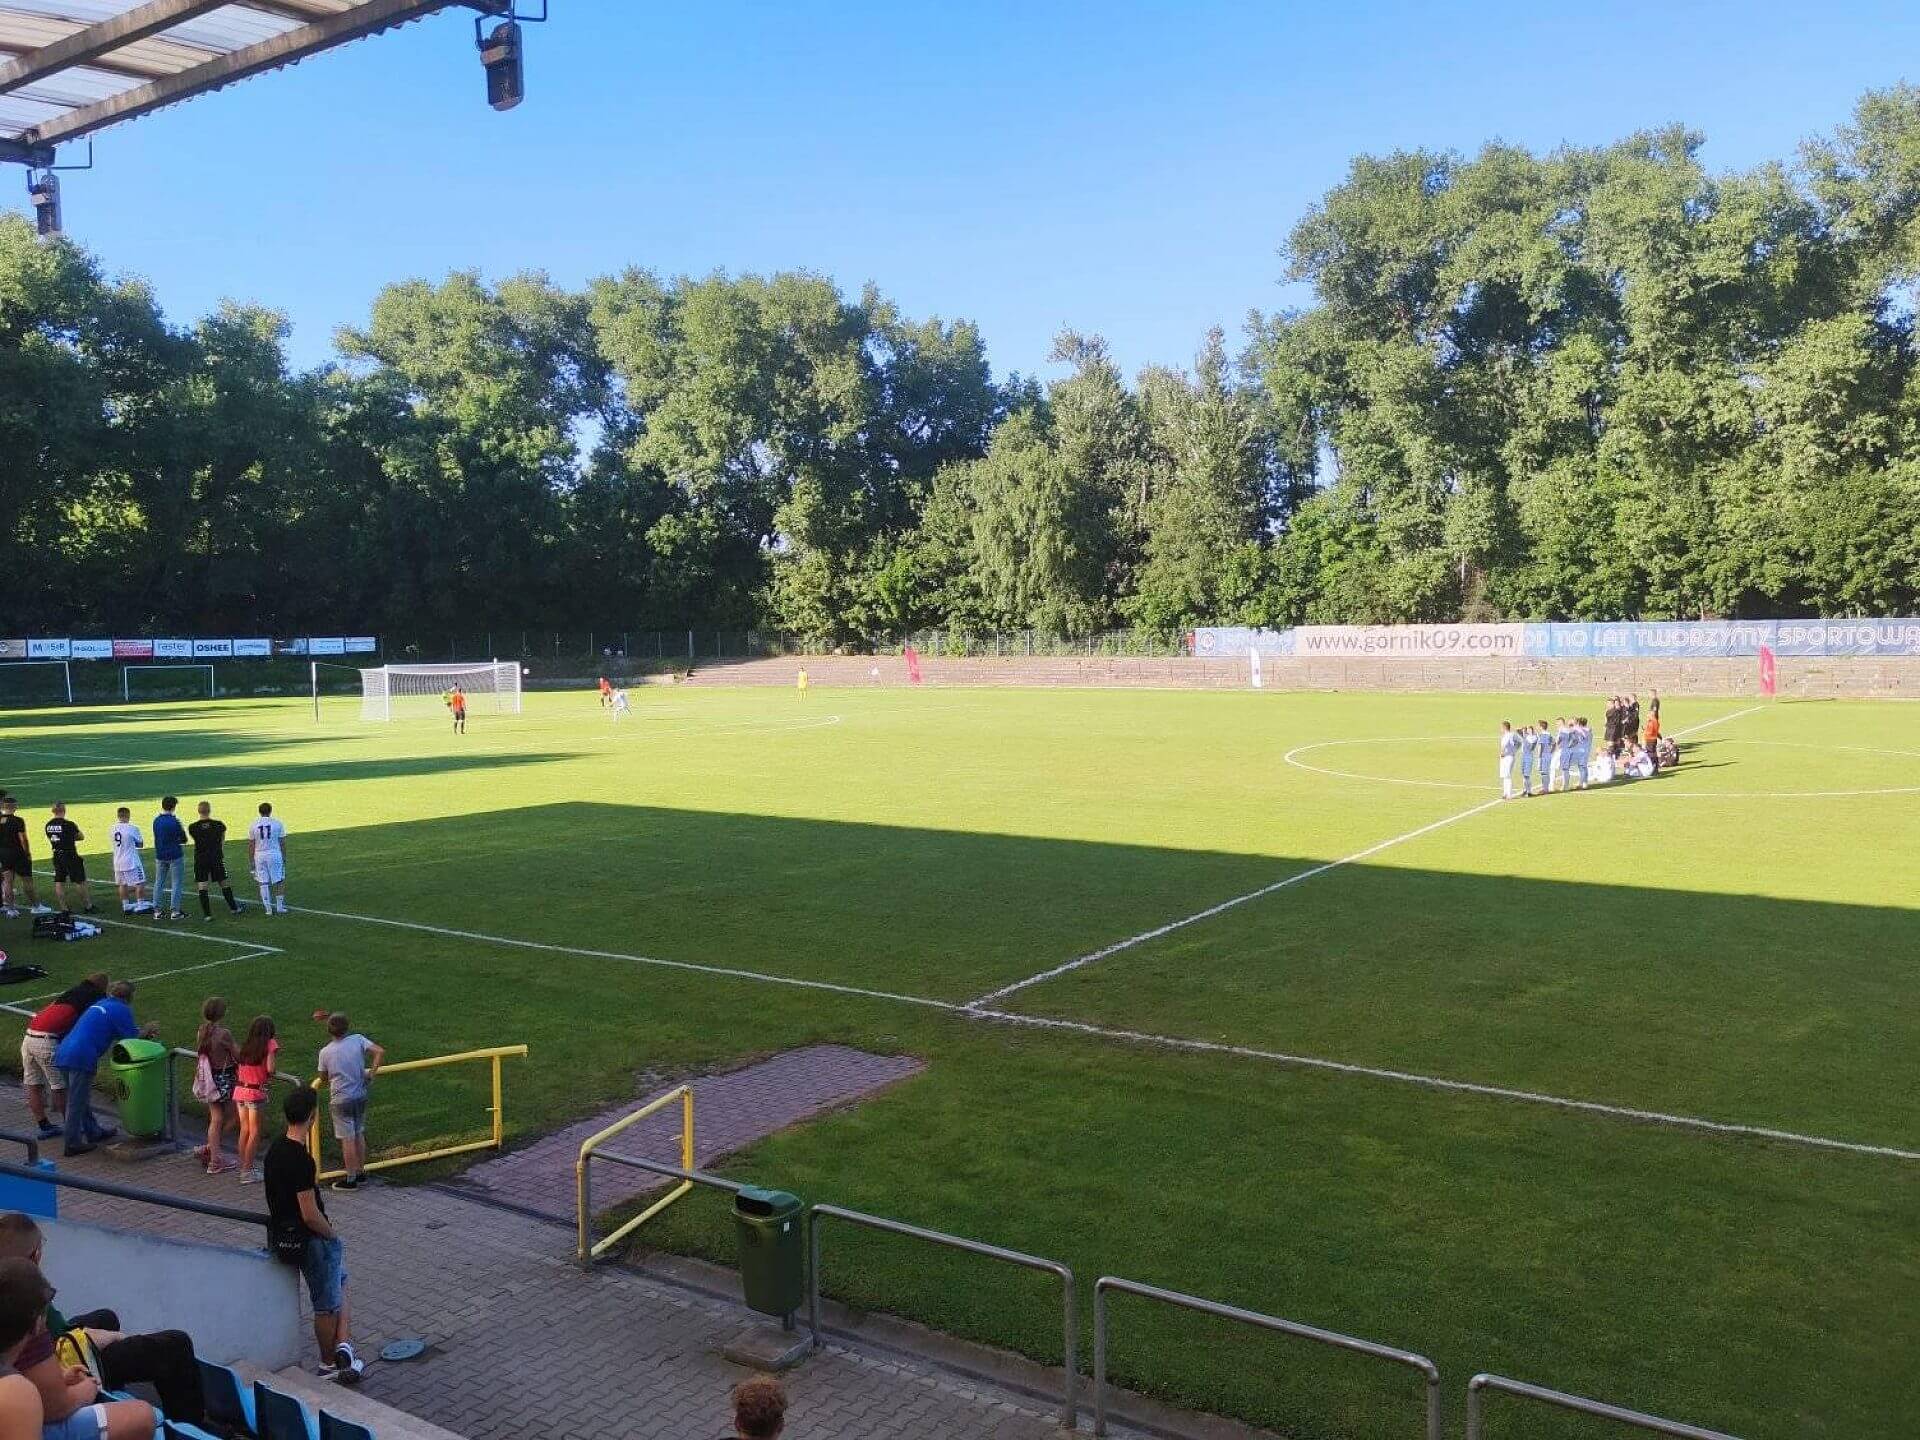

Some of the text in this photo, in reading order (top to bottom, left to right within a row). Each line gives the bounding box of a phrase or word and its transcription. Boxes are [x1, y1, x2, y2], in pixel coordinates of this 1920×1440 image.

[196, 644, 230, 652] OSHEE
[1306, 630, 1515, 653] www.gornik09.com
[114, 831, 122, 847] 9
[257, 825, 272, 840] 11
